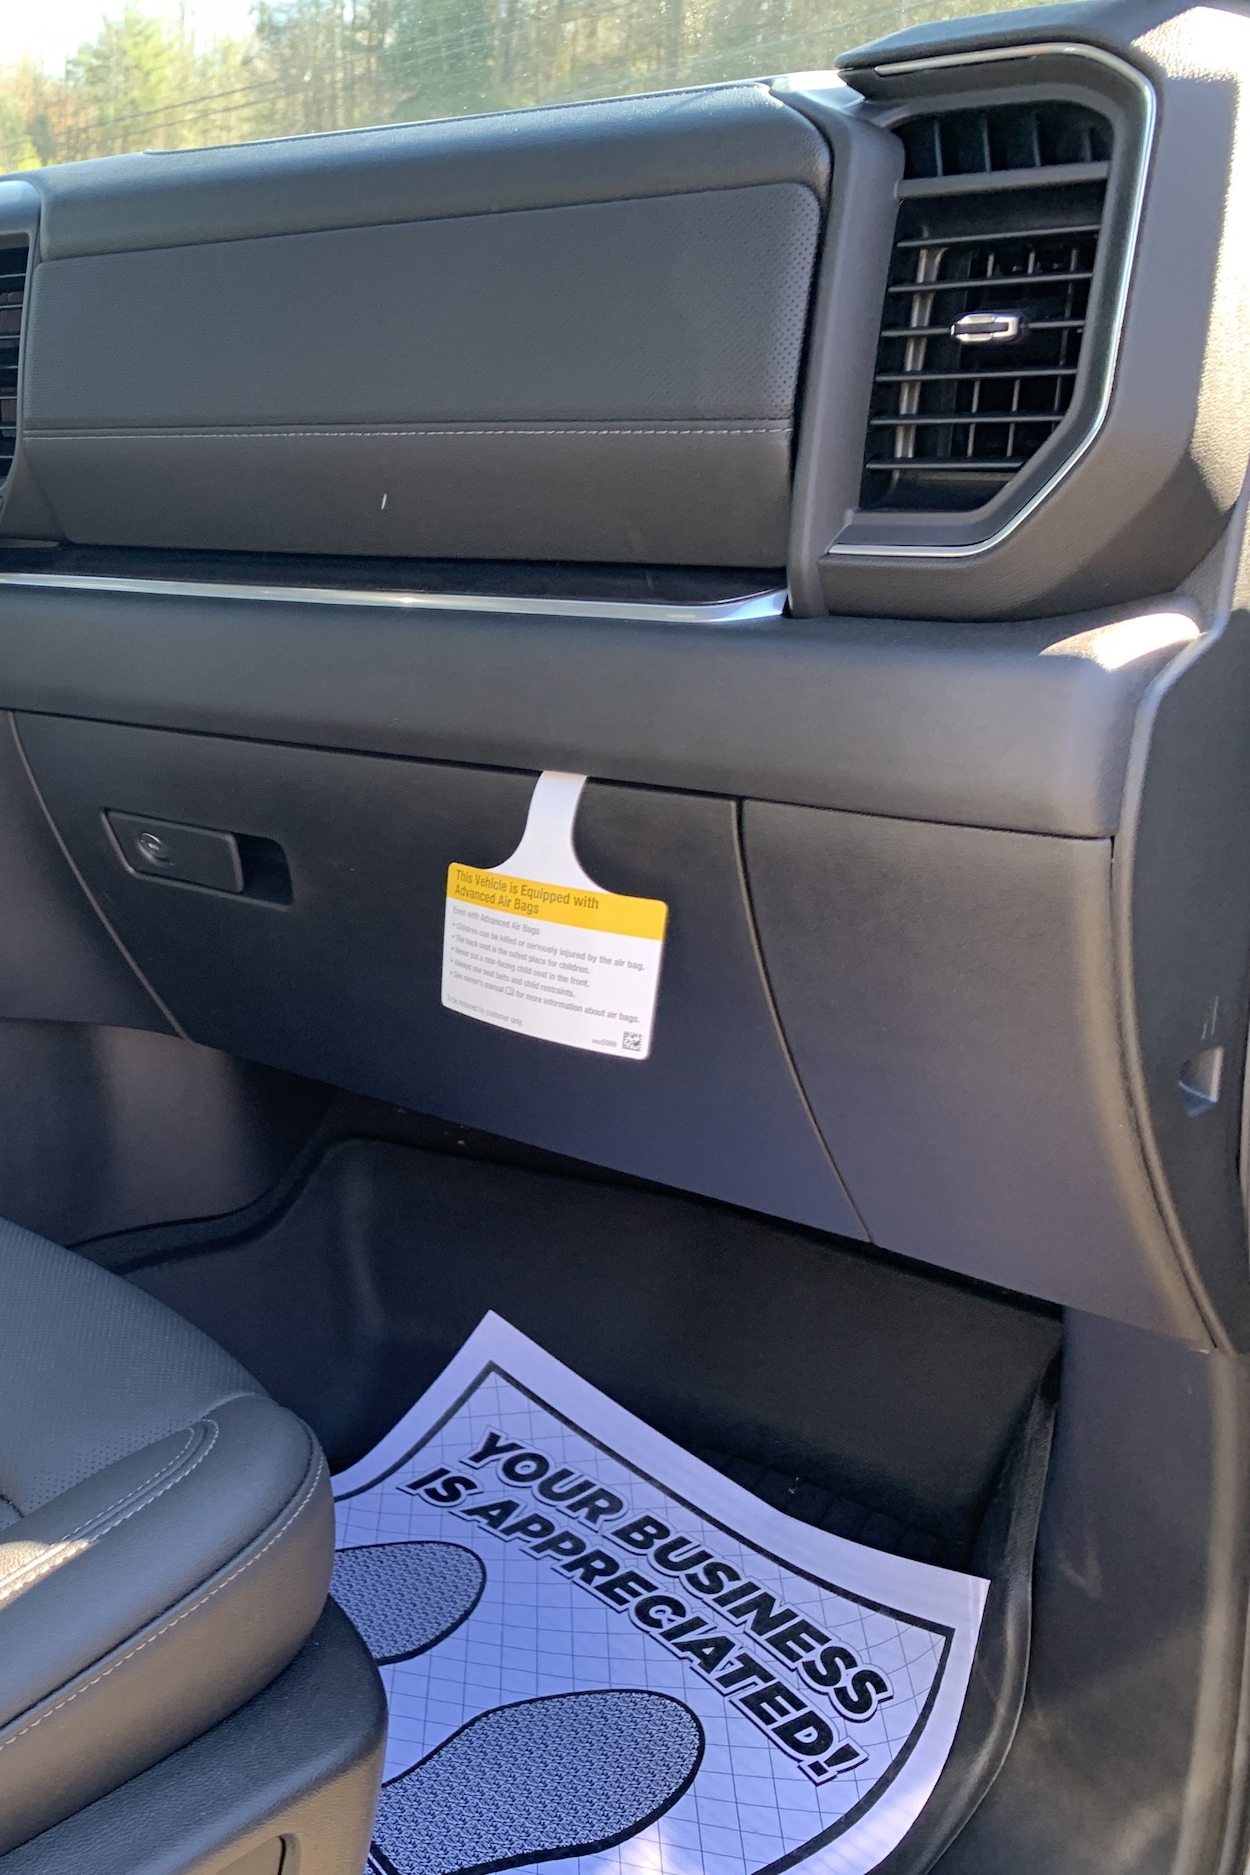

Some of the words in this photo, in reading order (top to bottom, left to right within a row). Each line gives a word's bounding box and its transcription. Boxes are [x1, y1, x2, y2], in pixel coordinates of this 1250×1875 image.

[454, 884, 495, 904] Advanced
[497, 894, 512, 908] Air
[514, 898, 540, 915] Bags
[456, 869, 473, 884] This
[475, 873, 507, 892] Vehicle
[510, 882, 518, 894] is
[521, 884, 571, 905] Equipped
[573, 895, 599, 909] with
[453, 906, 466, 916] Even
[467, 911, 479, 920] with
[480, 914, 510, 928] Advanced
[511, 921, 521, 930] Air
[522, 924, 540, 936] Bags
[456, 922, 478, 935] Children
[479, 930, 490, 938] can
[500, 935, 517, 945] killed
[526, 942, 558, 956] seriously
[560, 947, 586, 960] injured
[587, 954, 597, 963] by
[599, 955, 612, 965] the
[614, 959, 625, 967] air
[627, 961, 645, 971] bag.
[479, 943, 491, 951] seat
[498, 947, 507, 955] the
[509, 951, 527, 960] safest
[528, 956, 546, 965] place
[548, 959, 558, 967] for
[559, 962, 590, 974] children.
[470, 952, 479, 960] put
[517, 966, 532, 975] child
[533, 970, 547, 978] seat
[549, 972, 555, 980] in
[557, 974, 569, 983] the
[570, 977, 590, 987] front.
[511, 977, 523, 985] and
[523, 980, 540, 989] child
[541, 984, 576, 998] restraints.
[516, 990, 525, 998] for
[525, 994, 542, 1003] more
[543, 998, 583, 1012] information
[584, 1006, 606, 1017] about
[607, 1010, 618, 1019] air
[619, 1012, 640, 1023] bags.
[464, 1431, 627, 1525] YOUR
[612, 1515, 890, 1716] BUSINESS
[405, 1467, 479, 1502] IS
[466, 1498, 863, 1778] APPRECIATED!
